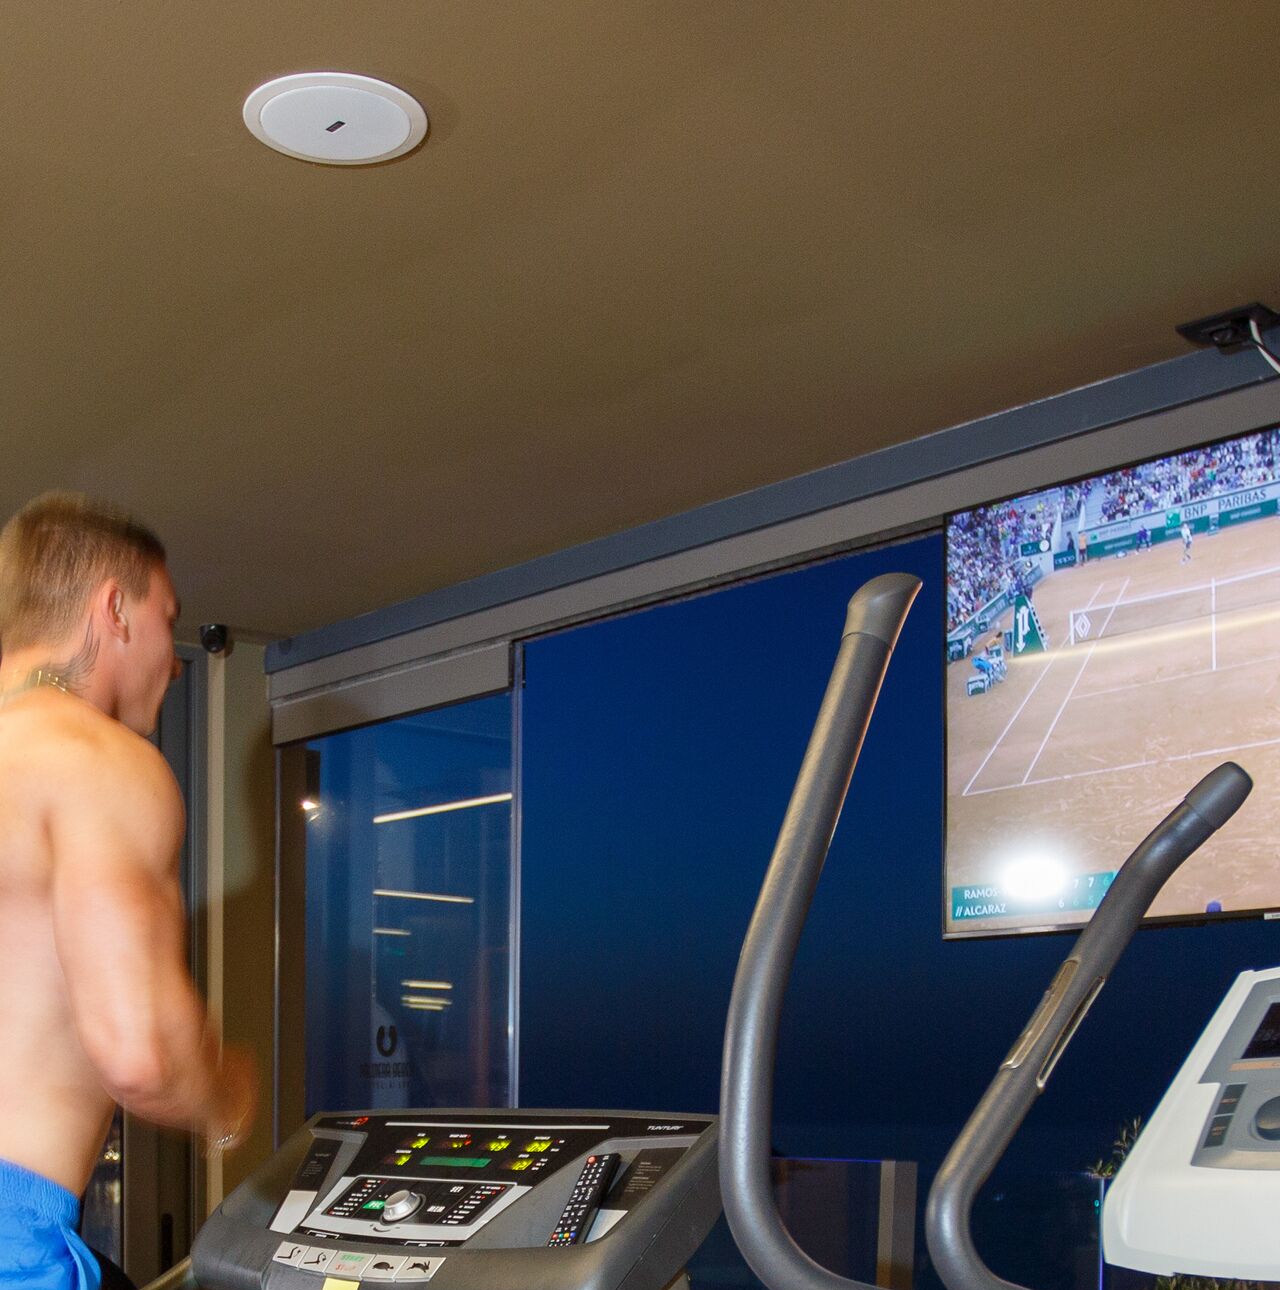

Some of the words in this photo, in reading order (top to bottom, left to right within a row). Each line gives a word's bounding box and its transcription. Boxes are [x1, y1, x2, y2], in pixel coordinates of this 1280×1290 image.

[1184, 504, 1207, 519] BNP
[1219, 490, 1267, 511] PARIBAS
[964, 904, 1006, 917] ALCARAZ
